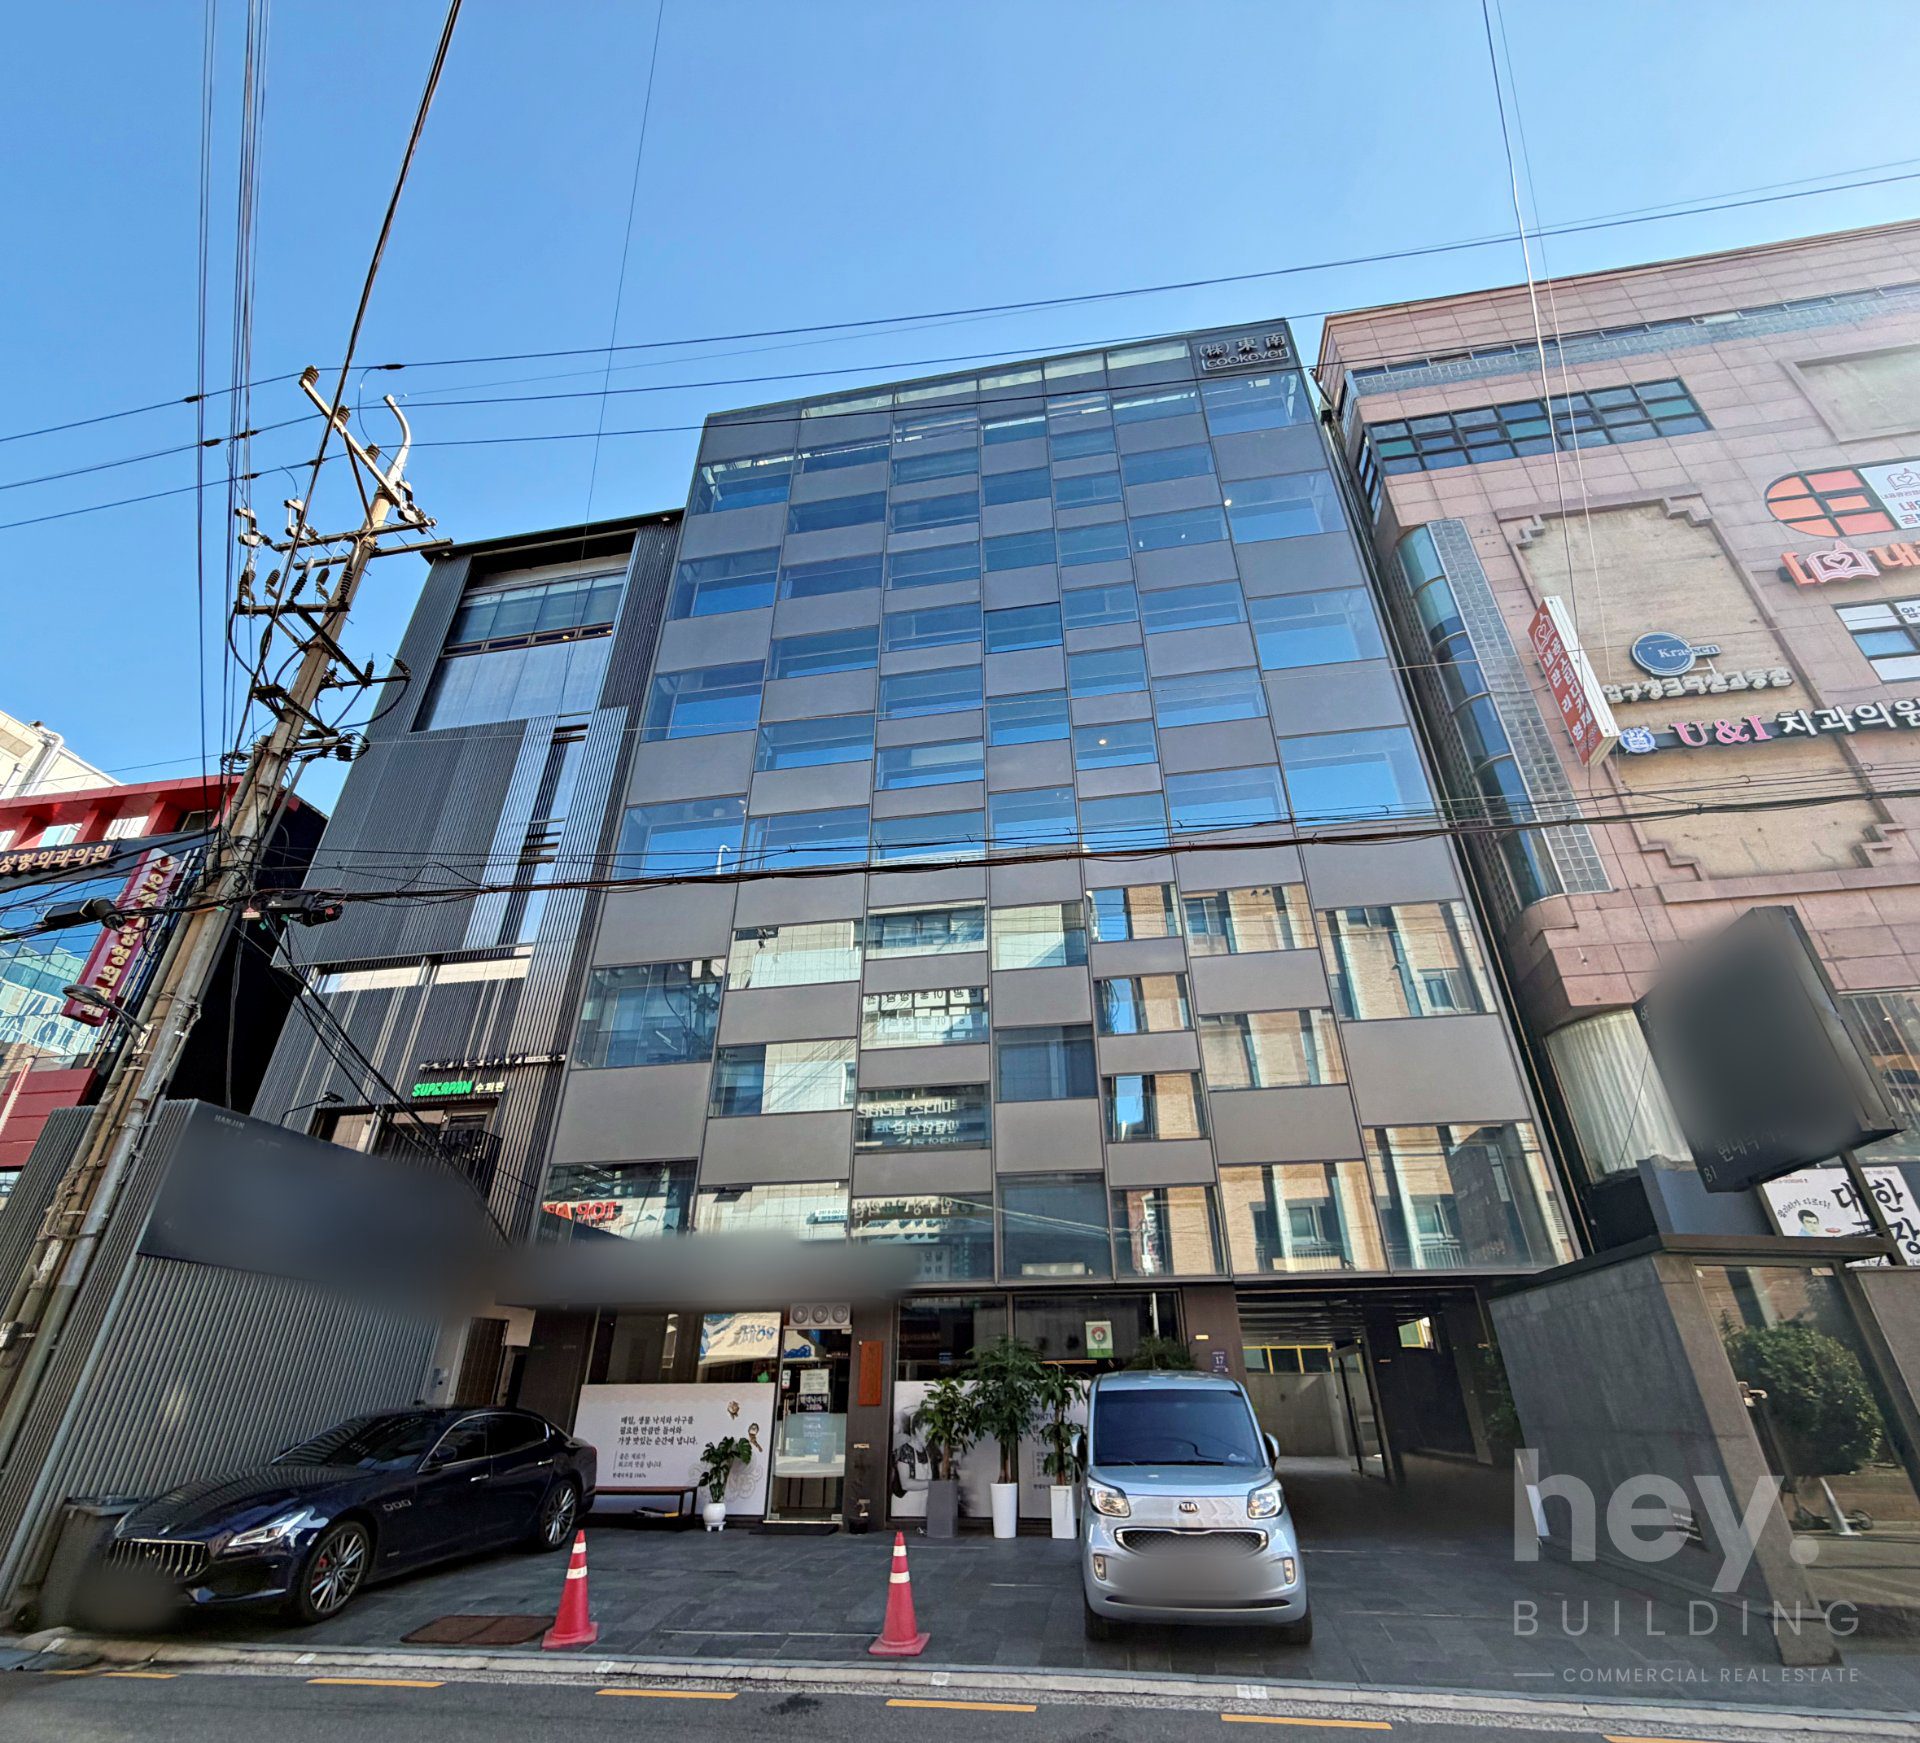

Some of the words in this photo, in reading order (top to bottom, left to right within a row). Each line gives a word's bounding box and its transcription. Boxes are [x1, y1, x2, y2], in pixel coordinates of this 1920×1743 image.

[1207, 349, 1285, 368] cookever
[412, 1081, 473, 1097] SUPERPAN
[1180, 1503, 1196, 1511] KIA
